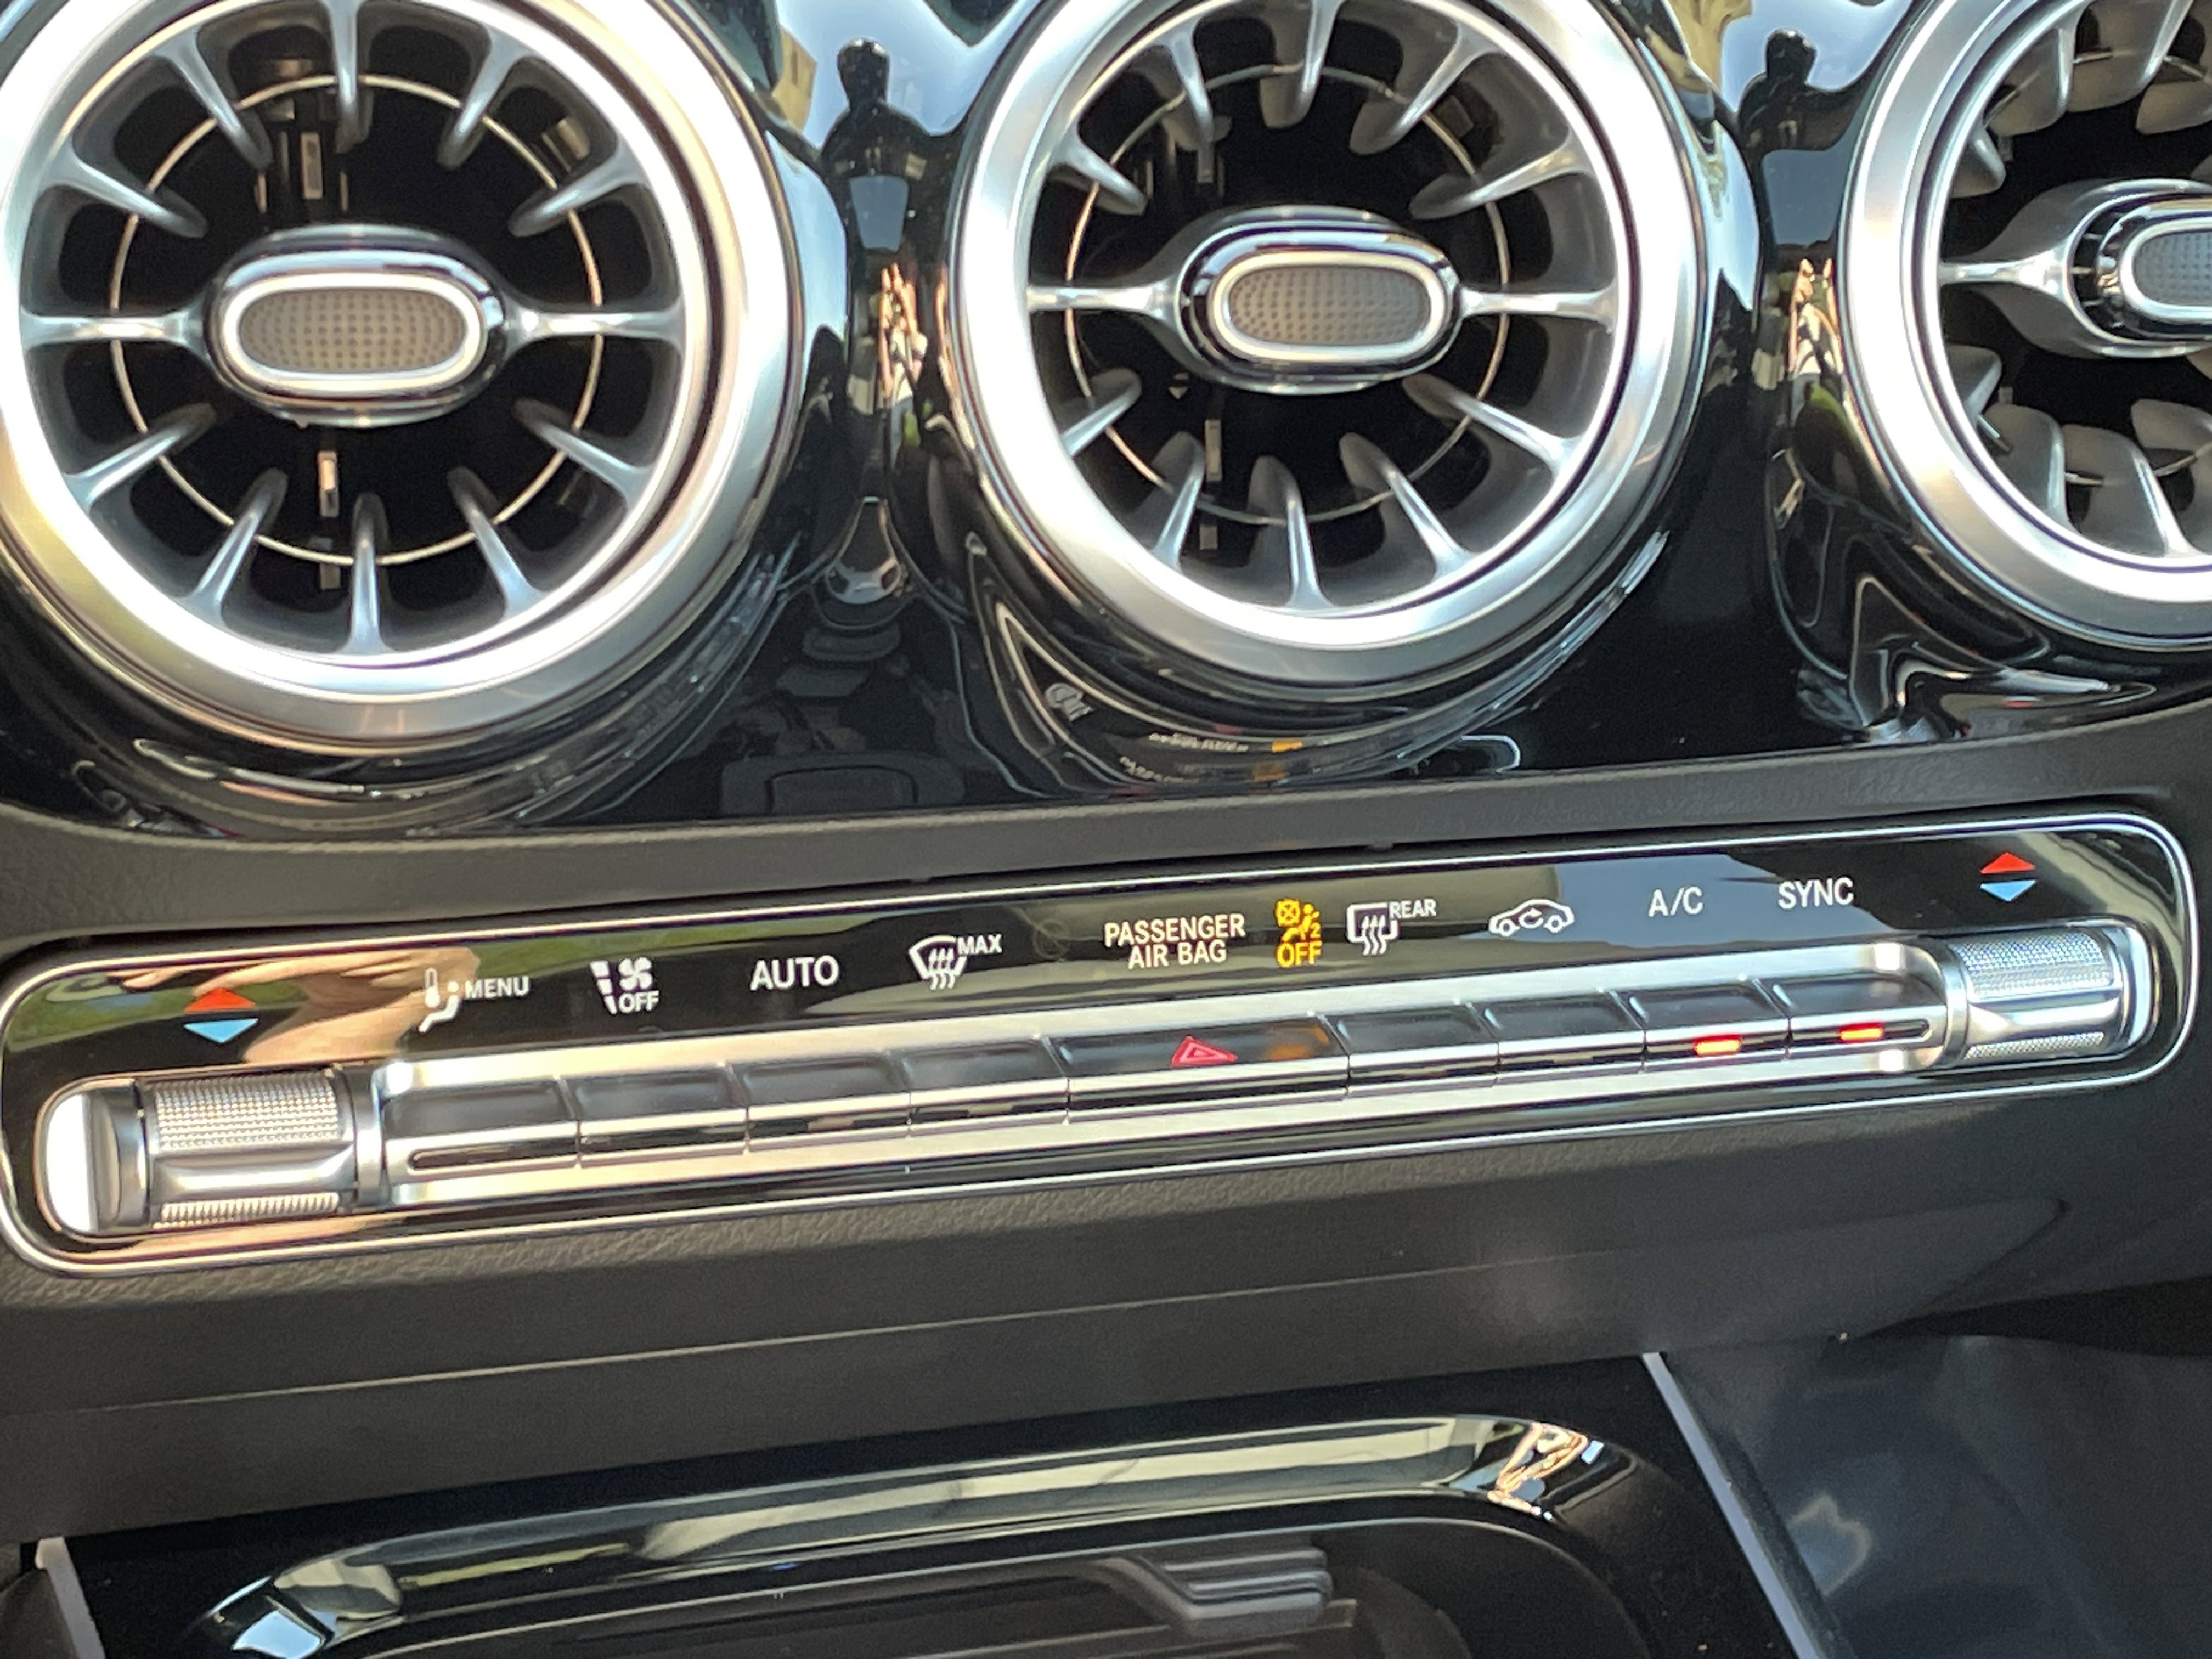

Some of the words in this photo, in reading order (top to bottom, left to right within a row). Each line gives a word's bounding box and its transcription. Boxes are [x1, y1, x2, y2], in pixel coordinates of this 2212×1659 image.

[1648, 886, 1703, 917] A/C
[1778, 877, 1854, 909] SYNC
[1389, 899, 1437, 918] REAR
[1104, 913, 1246, 947] PASSENGER
[957, 934, 1002, 956] MAX
[1127, 944, 1169, 969] AIR
[1177, 940, 1227, 966] BAG
[1276, 941, 1322, 967] OFF
[750, 955, 840, 991] AUTO
[464, 975, 530, 999] MENU
[619, 990, 659, 1013] OFF
